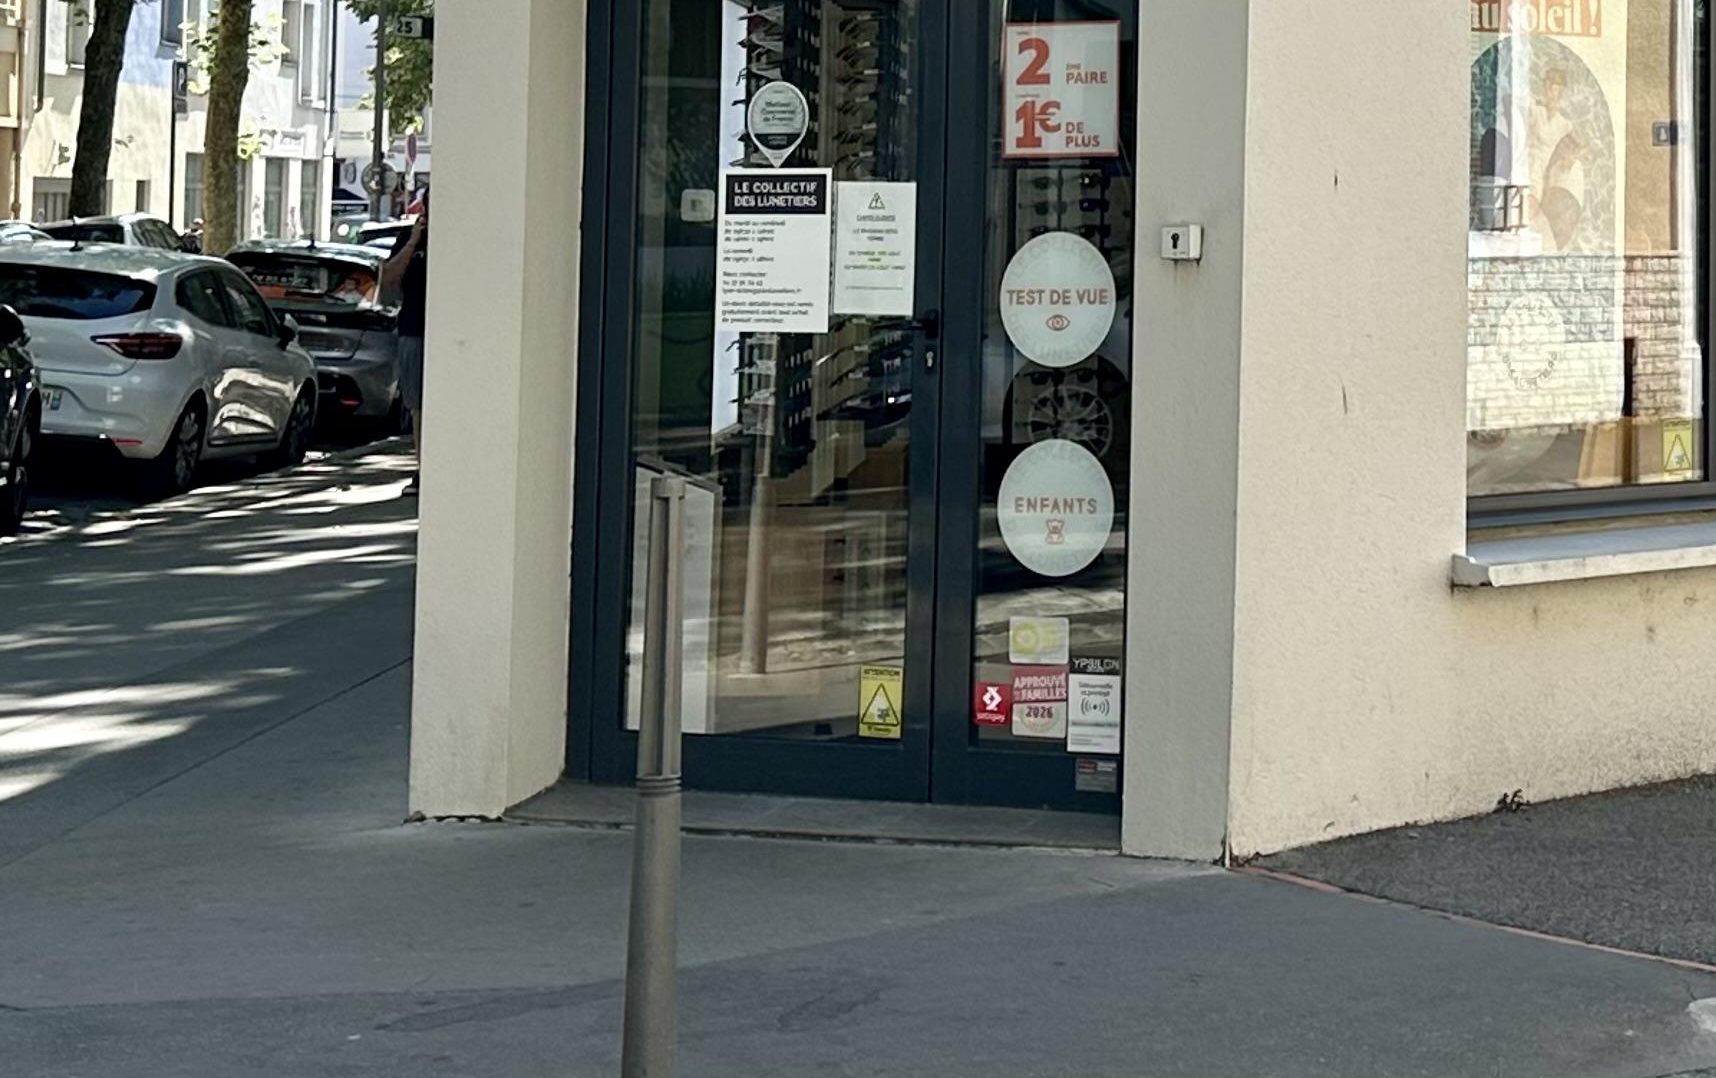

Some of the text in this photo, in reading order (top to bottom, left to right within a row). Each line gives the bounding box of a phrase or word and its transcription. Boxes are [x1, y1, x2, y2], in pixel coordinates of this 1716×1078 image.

[1016, 37, 1051, 85] 2
[1065, 71, 1109, 84] PAIRE
[1015, 100, 1061, 148] 1€
[1065, 122, 1085, 134] DE
[1065, 135, 1101, 147] PLUS
[734, 182, 817, 193] LE COLLECTIF
[734, 194, 817, 207] DES LUNETIERS
[1007, 289, 1109, 305] TEST DE VUE
[1014, 496, 1098, 514] ENFANTS
[1025, 706, 1054, 718] 2026
